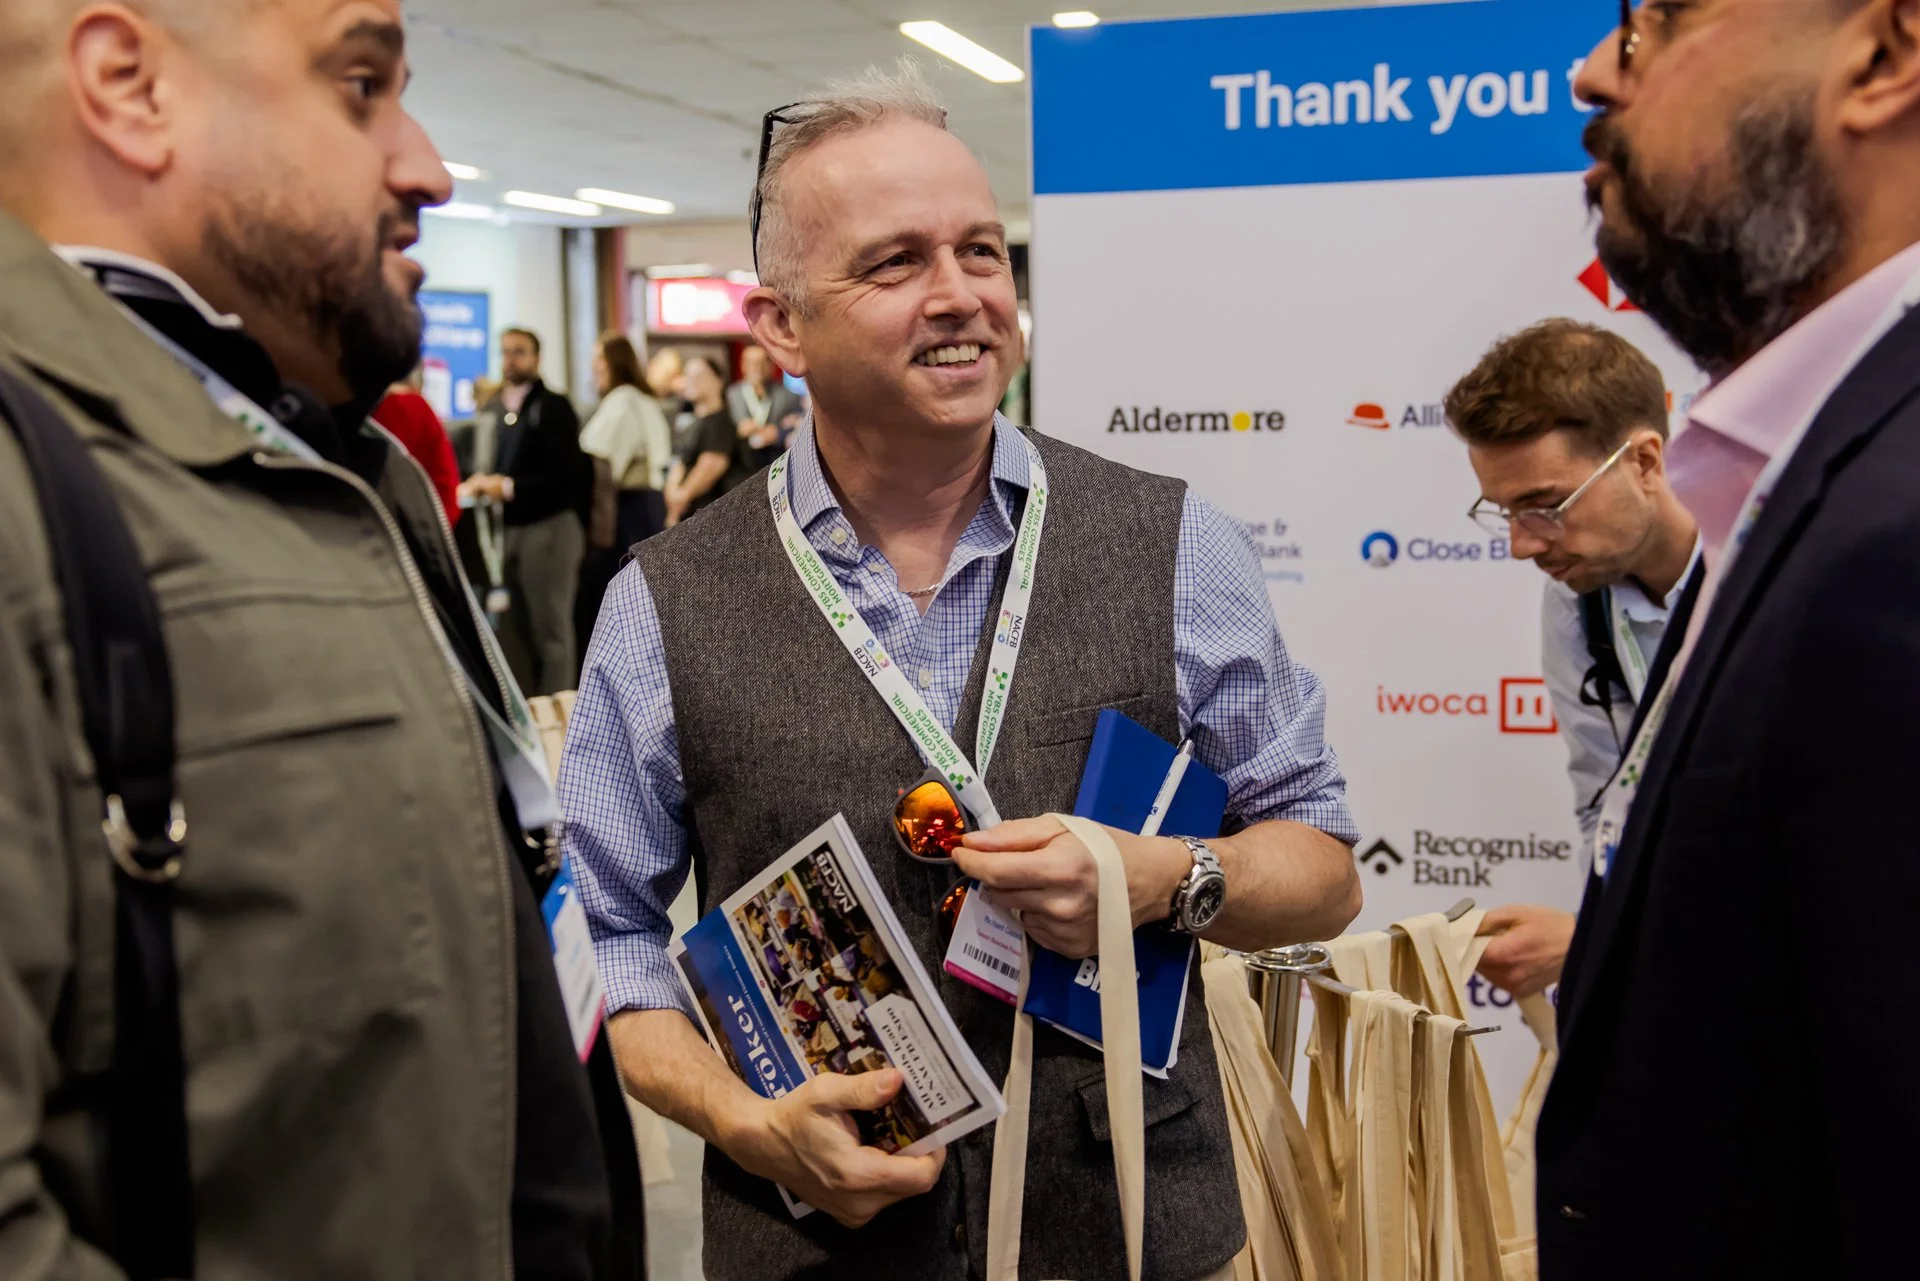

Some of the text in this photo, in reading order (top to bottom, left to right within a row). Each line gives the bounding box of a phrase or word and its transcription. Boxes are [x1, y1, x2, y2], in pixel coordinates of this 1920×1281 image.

[1210, 63, 1413, 130] Thank
[1428, 69, 1550, 134] you
[1107, 406, 1286, 434] Aldermore
[1400, 404, 1442, 428] Alli
[772, 495, 780, 522] NACFB
[1017, 502, 1035, 562] MORTGAGES
[1019, 508, 1041, 590] YBS COMMERCIAL
[1408, 539, 1481, 560] Close
[785, 536, 834, 610] YBS COMMERCIAL
[801, 549, 842, 603] MORTGAGES
[1009, 615, 1022, 648] NACFB
[853, 646, 878, 677] NACFB
[992, 694, 1002, 714] YBS
[1377, 687, 1488, 715] iwoca
[889, 692, 950, 771] YBS COMMERCIAL
[915, 708, 959, 765] MORTGAGES
[978, 689, 994, 755] MORTGAGES
[1413, 830, 1571, 863] Recognise
[814, 852, 853, 913] NACFB
[1413, 862, 1491, 888] Bank
[884, 1005, 909, 1041] Expo
[726, 990, 788, 1098] roker
[753, 1063, 774, 1100] OMMERCIAL
[881, 1023, 936, 1111] All roads lead
[904, 1041, 937, 1090] NACFB
[932, 1091, 947, 1107] to
